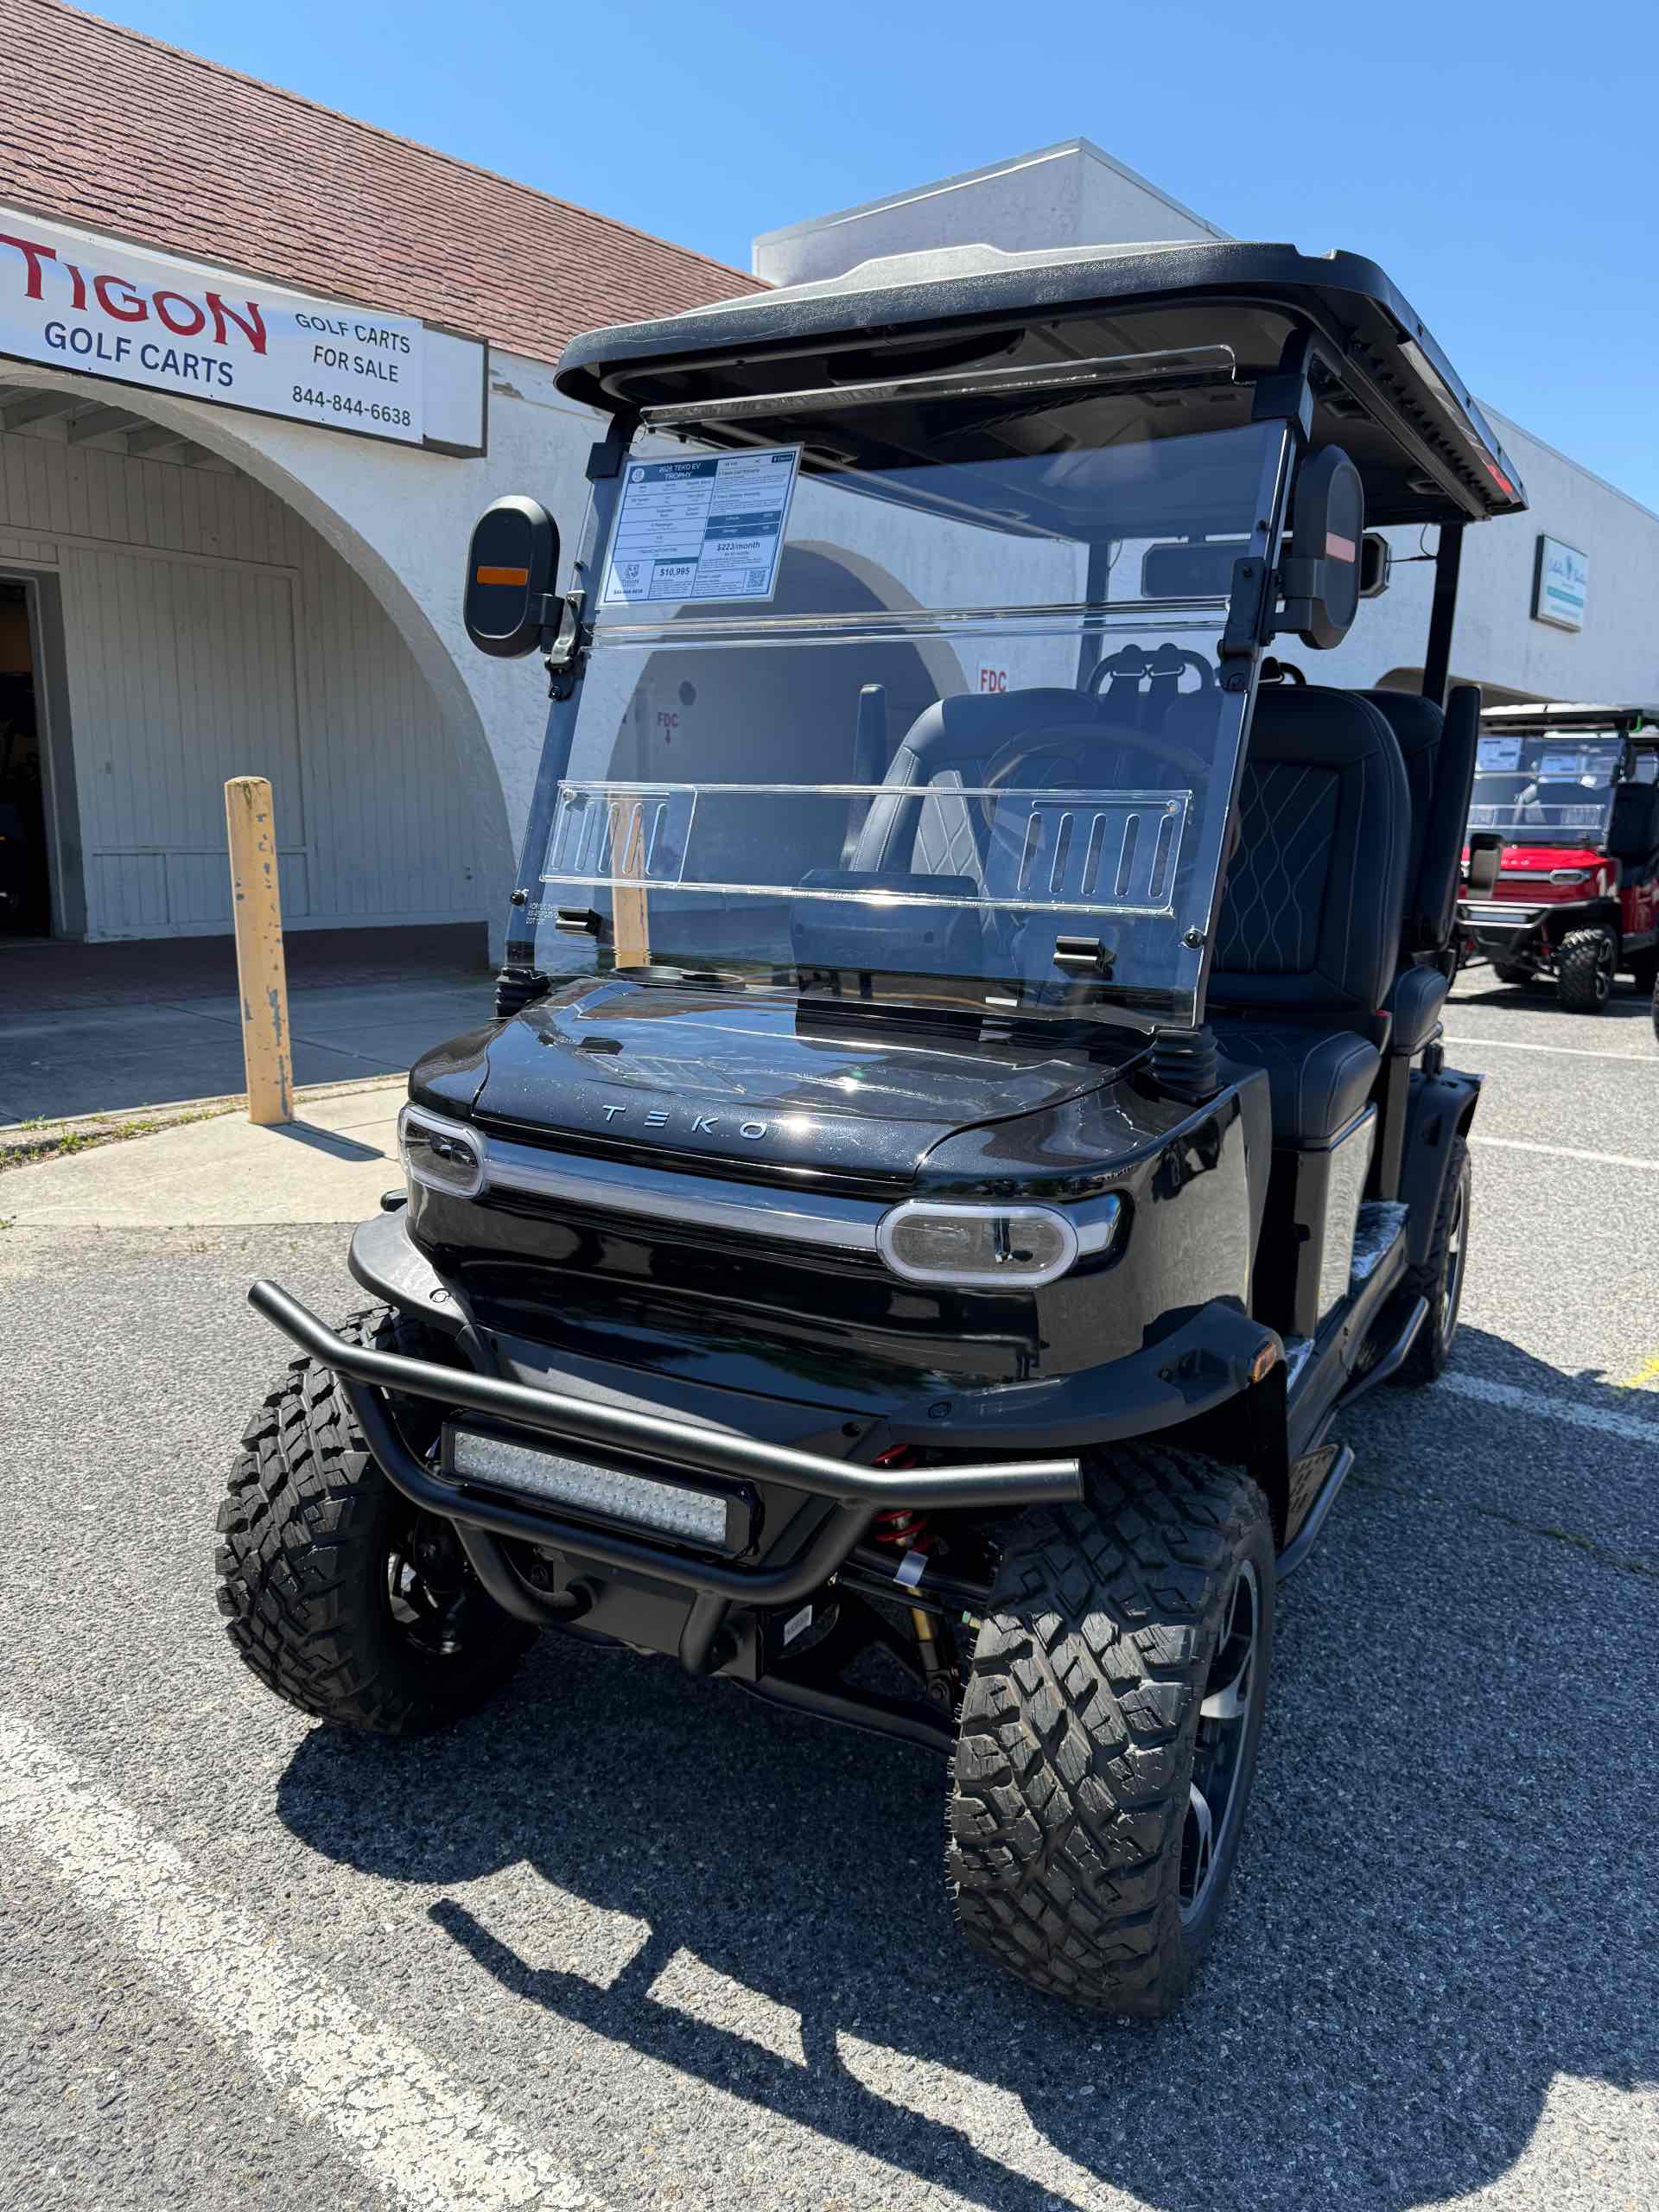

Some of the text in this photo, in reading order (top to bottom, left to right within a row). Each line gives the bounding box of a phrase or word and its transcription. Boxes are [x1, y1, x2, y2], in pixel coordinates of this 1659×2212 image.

[0, 233, 267, 355] TIGON
[295, 314, 410, 353] GOLF CARTS
[44, 321, 234, 387] GOLF CARTS
[313, 345, 398, 383] FOR SALE
[292, 385, 411, 427] 844-844-6638
[981, 669, 1007, 692] FDC
[657, 711, 679, 728] FDC
[601, 1103, 768, 1141] TEKO
